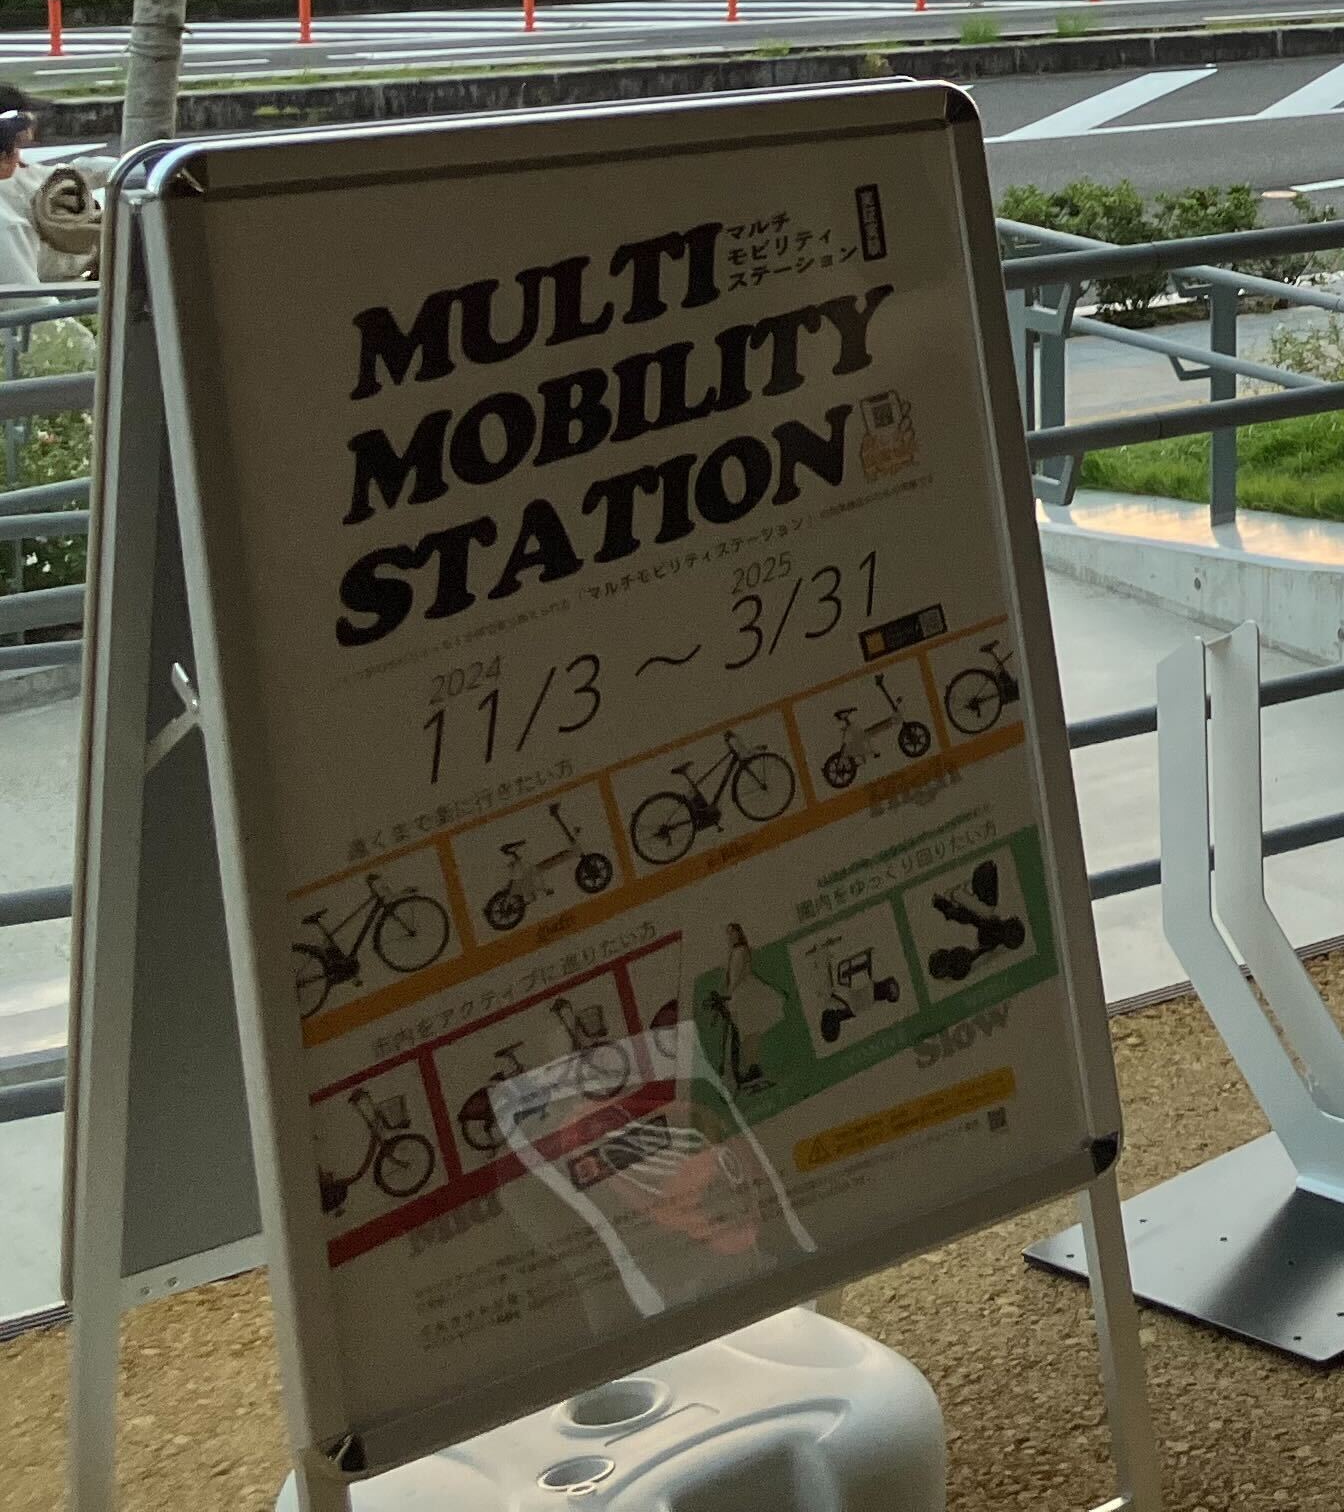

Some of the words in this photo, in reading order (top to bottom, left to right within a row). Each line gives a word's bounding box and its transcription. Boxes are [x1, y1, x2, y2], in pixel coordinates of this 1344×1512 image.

[724, 211, 790, 241] マルチ
[726, 227, 833, 266] モビリティ
[727, 244, 858, 292] ステーション
[350, 220, 723, 401] MULTI
[342, 284, 894, 526] MOBILITY
[335, 404, 853, 647] STATION
[731, 556, 792, 595] 2025
[423, 654, 601, 784] 11/3
[724, 551, 876, 670] 3/31
[428, 655, 500, 705] 2024
